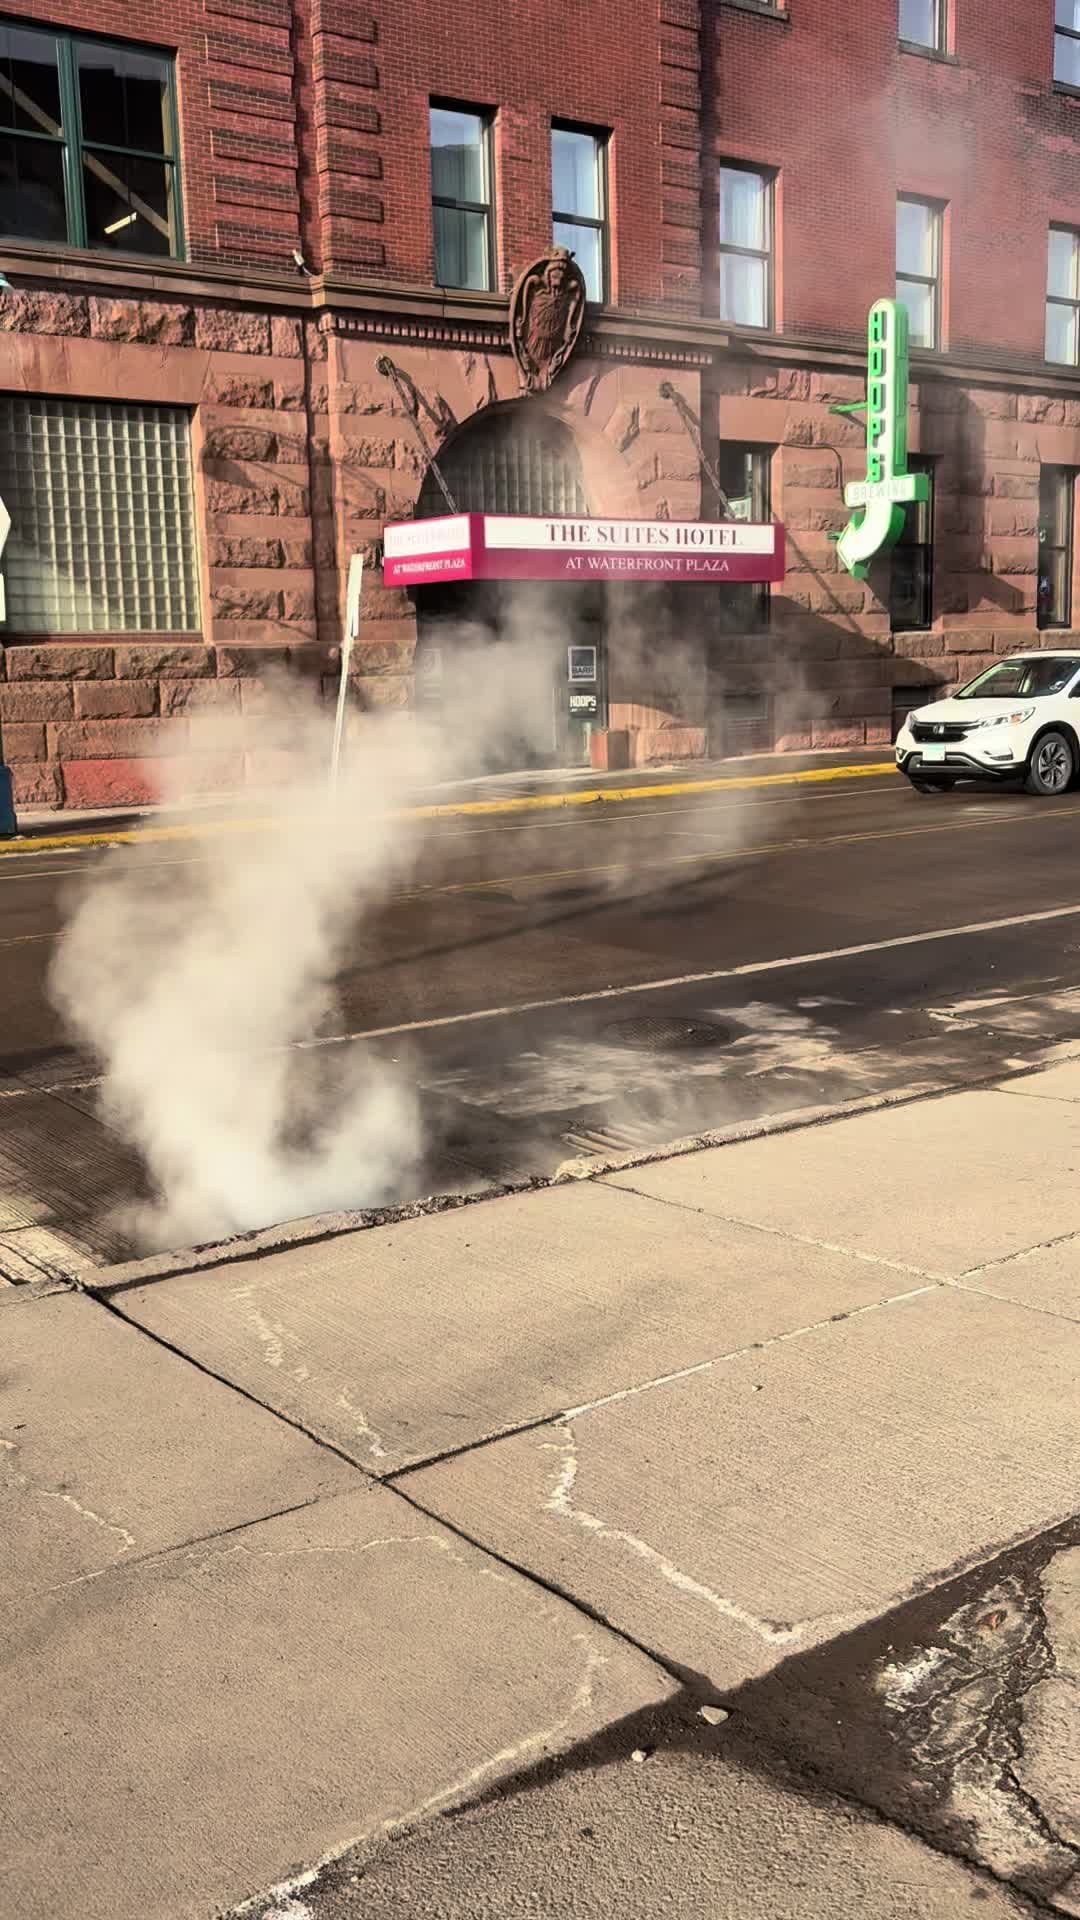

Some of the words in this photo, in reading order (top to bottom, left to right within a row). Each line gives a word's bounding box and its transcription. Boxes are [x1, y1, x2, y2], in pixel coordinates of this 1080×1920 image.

[869, 311, 884, 482] HOOPS
[545, 524, 591, 542] THE
[597, 525, 670, 544] SUITES
[675, 527, 743, 546] HOTEL
[445, 557, 465, 569] PLAZA
[565, 556, 583, 569] AT
[587, 556, 683, 571] WATERFRONT
[685, 559, 730, 572] PLAZA
[569, 695, 597, 707] HOOPS
